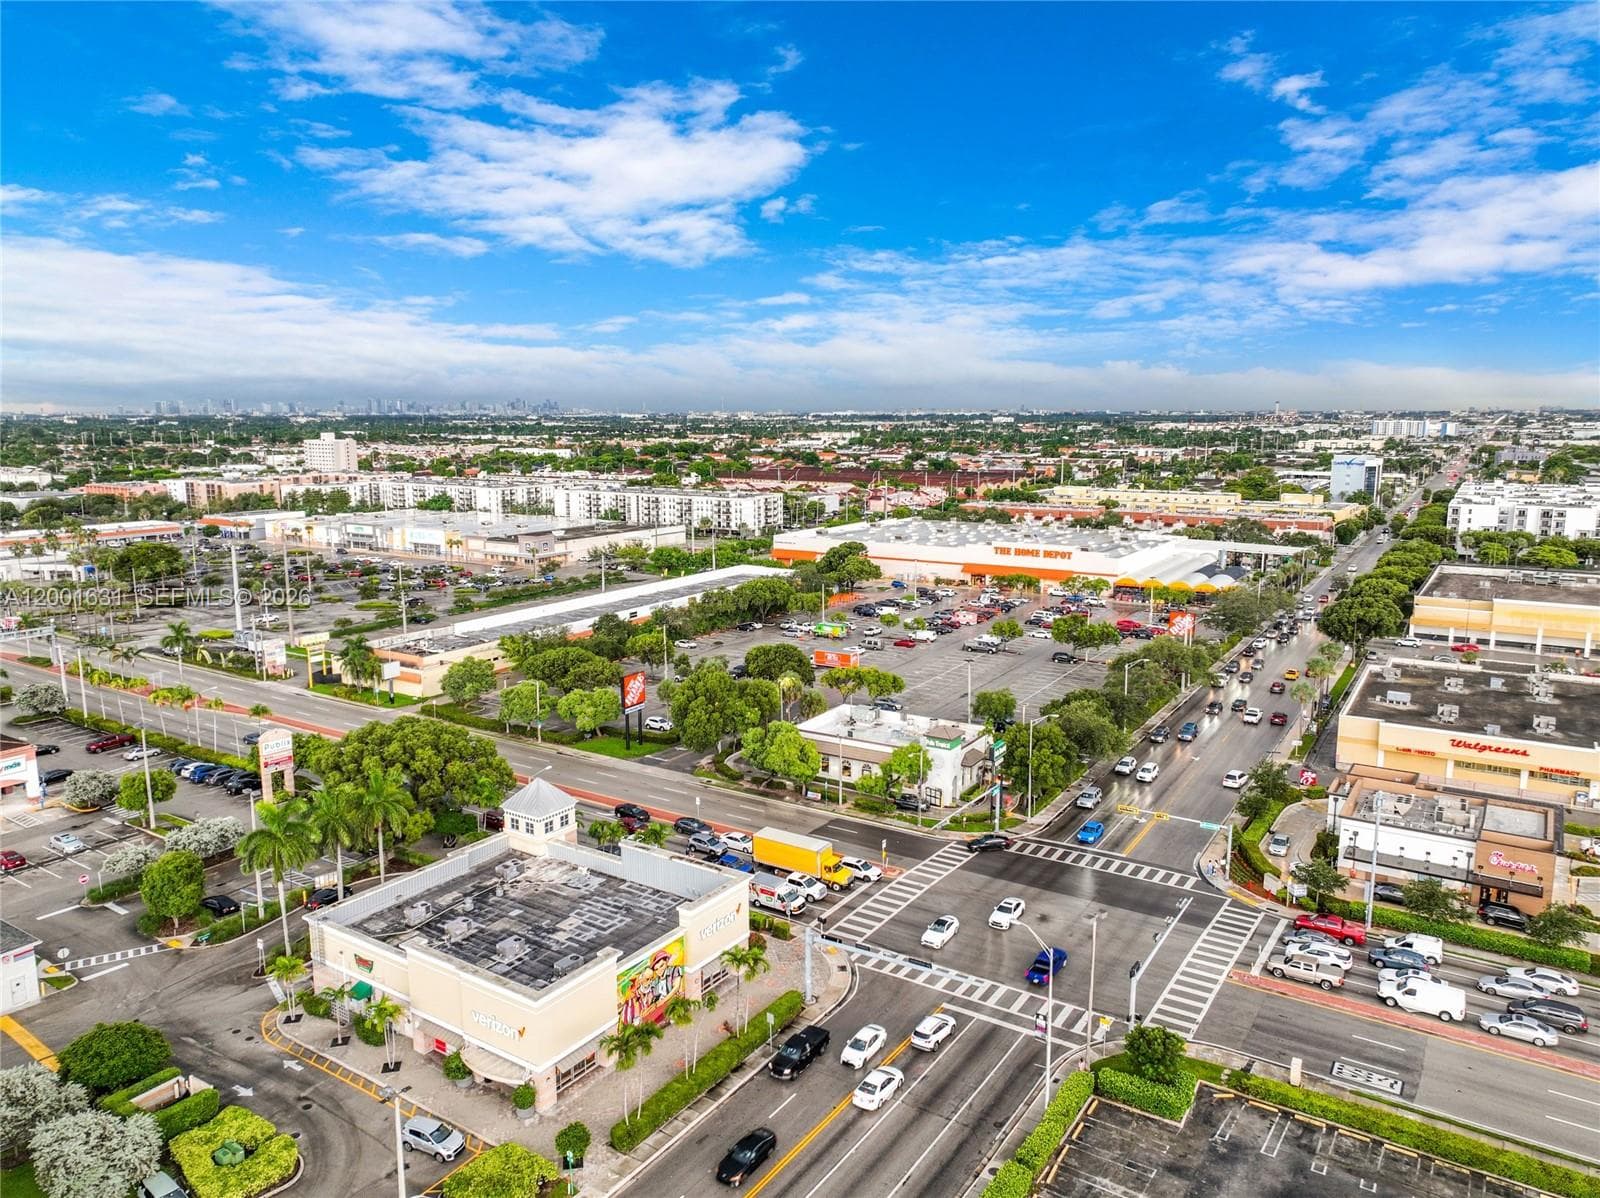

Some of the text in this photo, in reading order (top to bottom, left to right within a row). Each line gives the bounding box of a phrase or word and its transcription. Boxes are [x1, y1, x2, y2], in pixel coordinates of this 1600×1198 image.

[994, 547, 1073, 560] THE HOME DEPOT
[264, 738, 290, 751] Publix
[1449, 738, 1530, 757] Walgreens
[1539, 767, 1581, 777] PHARMACY
[698, 911, 736, 941] verizon
[471, 1009, 520, 1042] verizon
